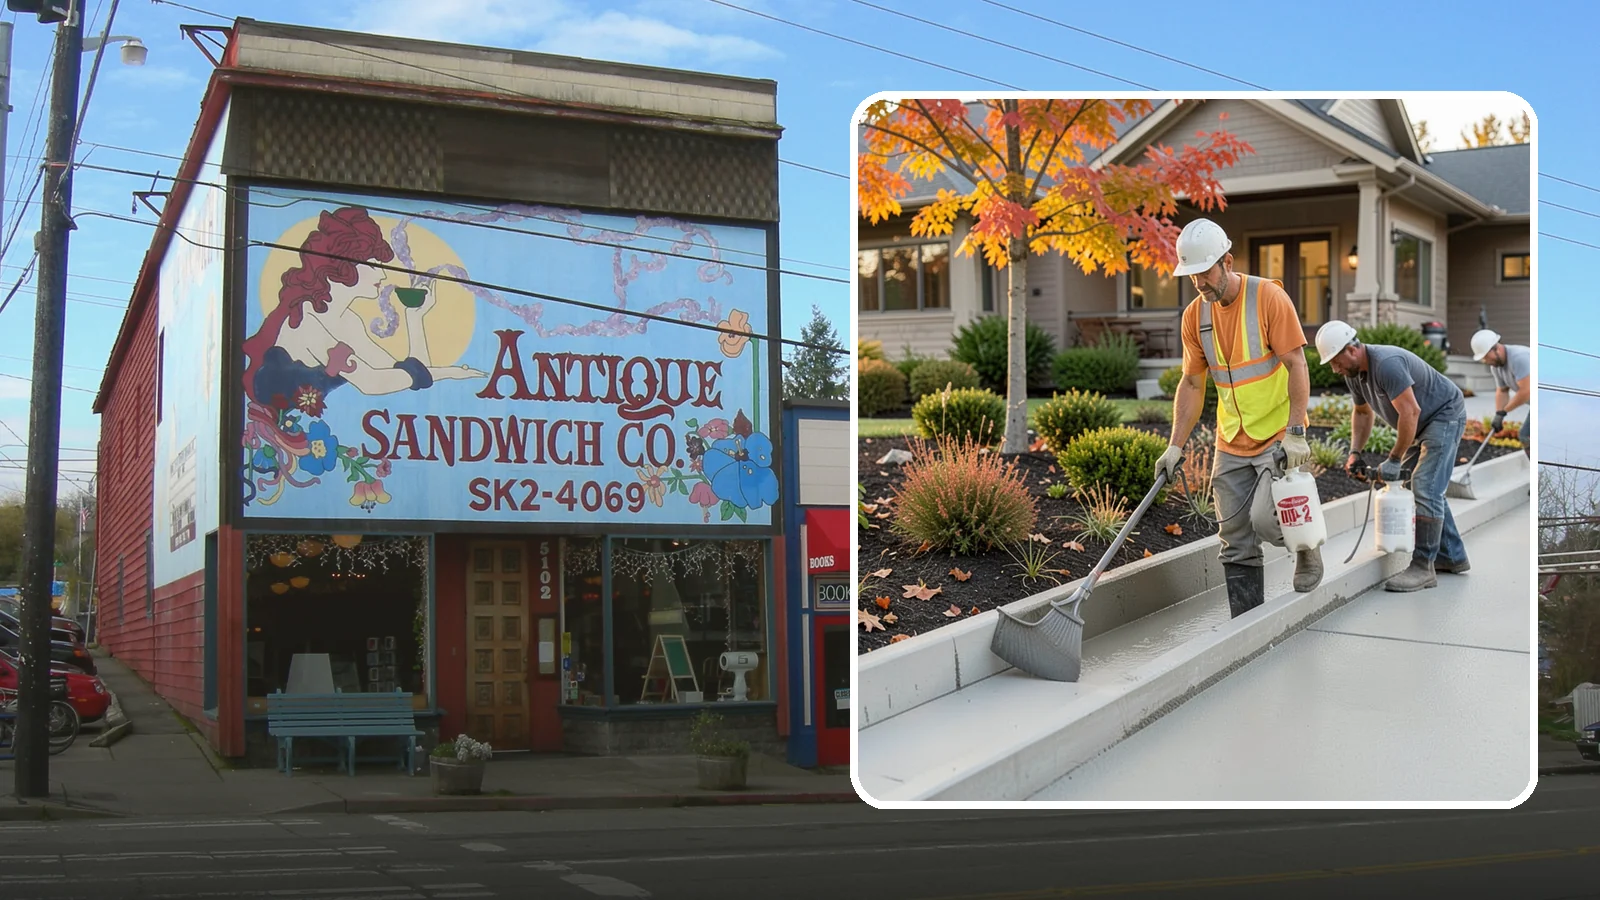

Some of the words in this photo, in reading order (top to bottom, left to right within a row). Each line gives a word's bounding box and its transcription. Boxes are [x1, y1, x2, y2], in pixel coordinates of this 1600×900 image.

[476, 329, 724, 421] ANTIQUE
[361, 408, 604, 467] SANDWICH
[616, 421, 685, 468] CO.
[468, 477, 646, 513] SK2-4069
[540, 541, 551, 600] 5102
[809, 556, 834, 568] BOOKS
